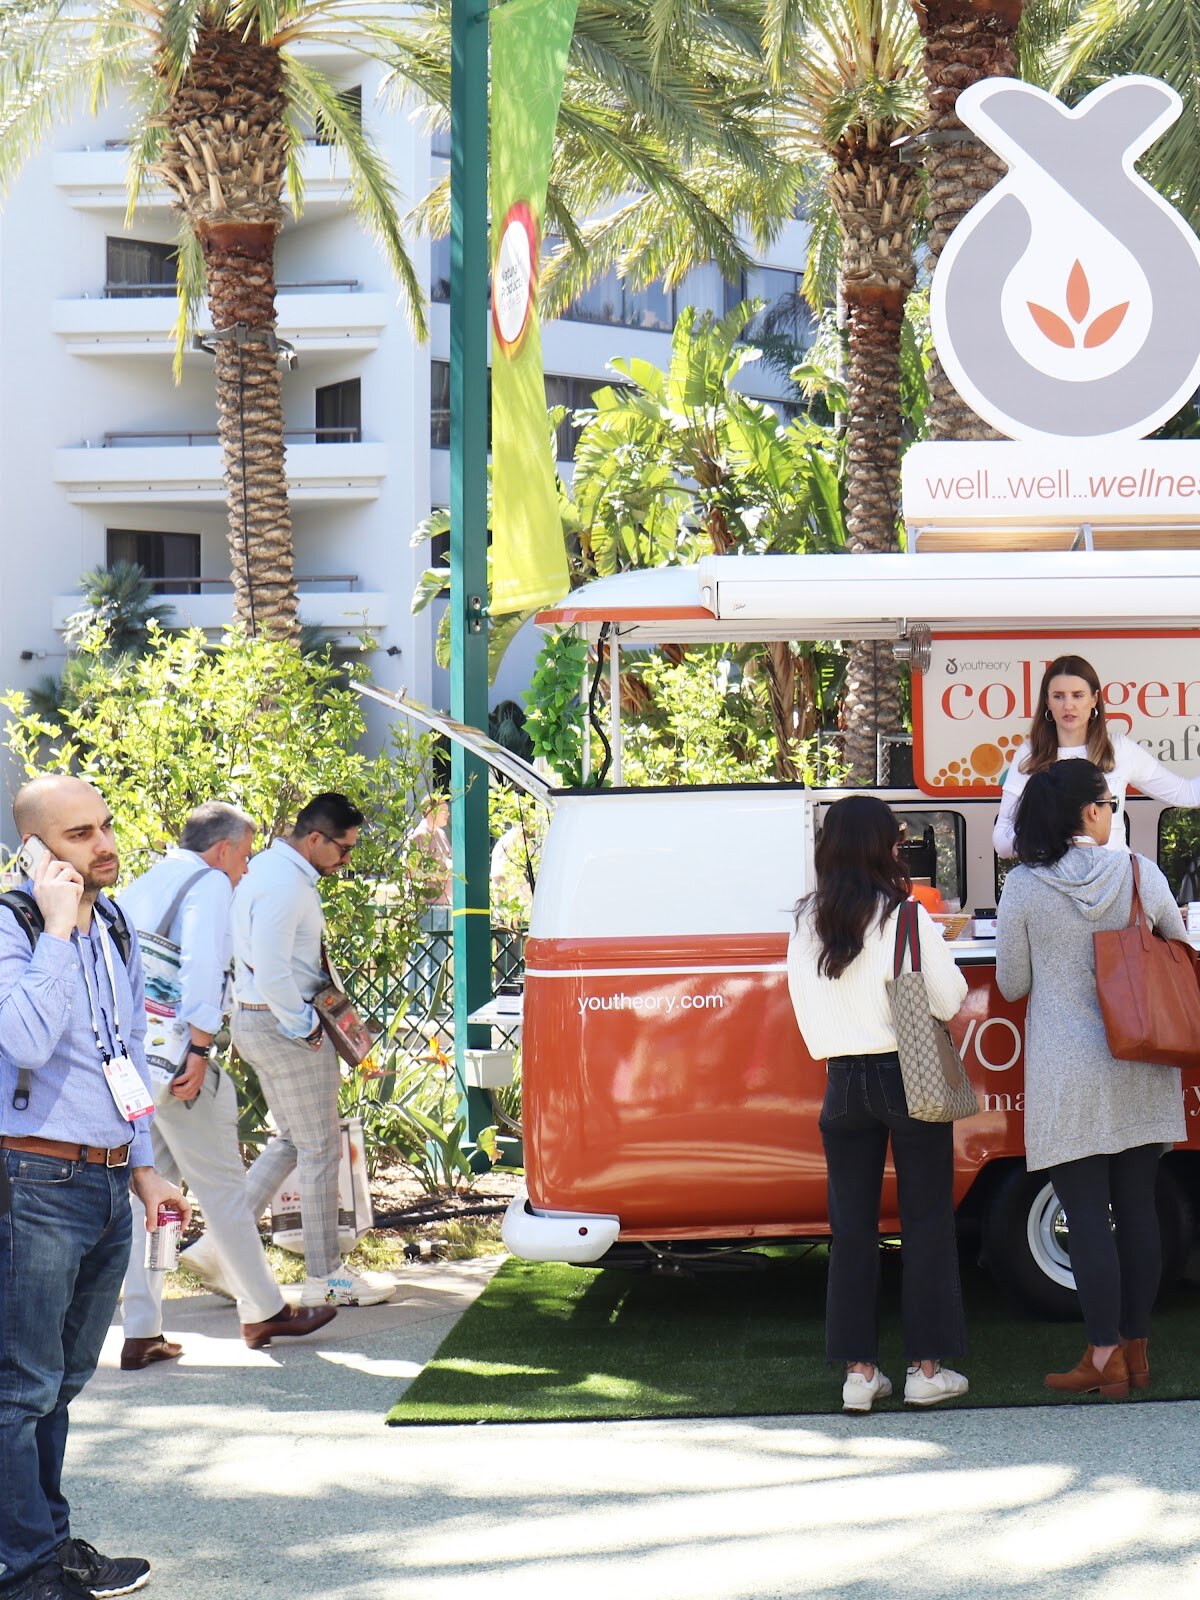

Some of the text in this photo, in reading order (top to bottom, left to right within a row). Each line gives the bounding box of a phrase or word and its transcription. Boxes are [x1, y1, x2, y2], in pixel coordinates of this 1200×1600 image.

[960, 660, 1010, 672] youtheory
[578, 993, 724, 1015] youtheory.com
[982, 1092, 1025, 1112] ma
